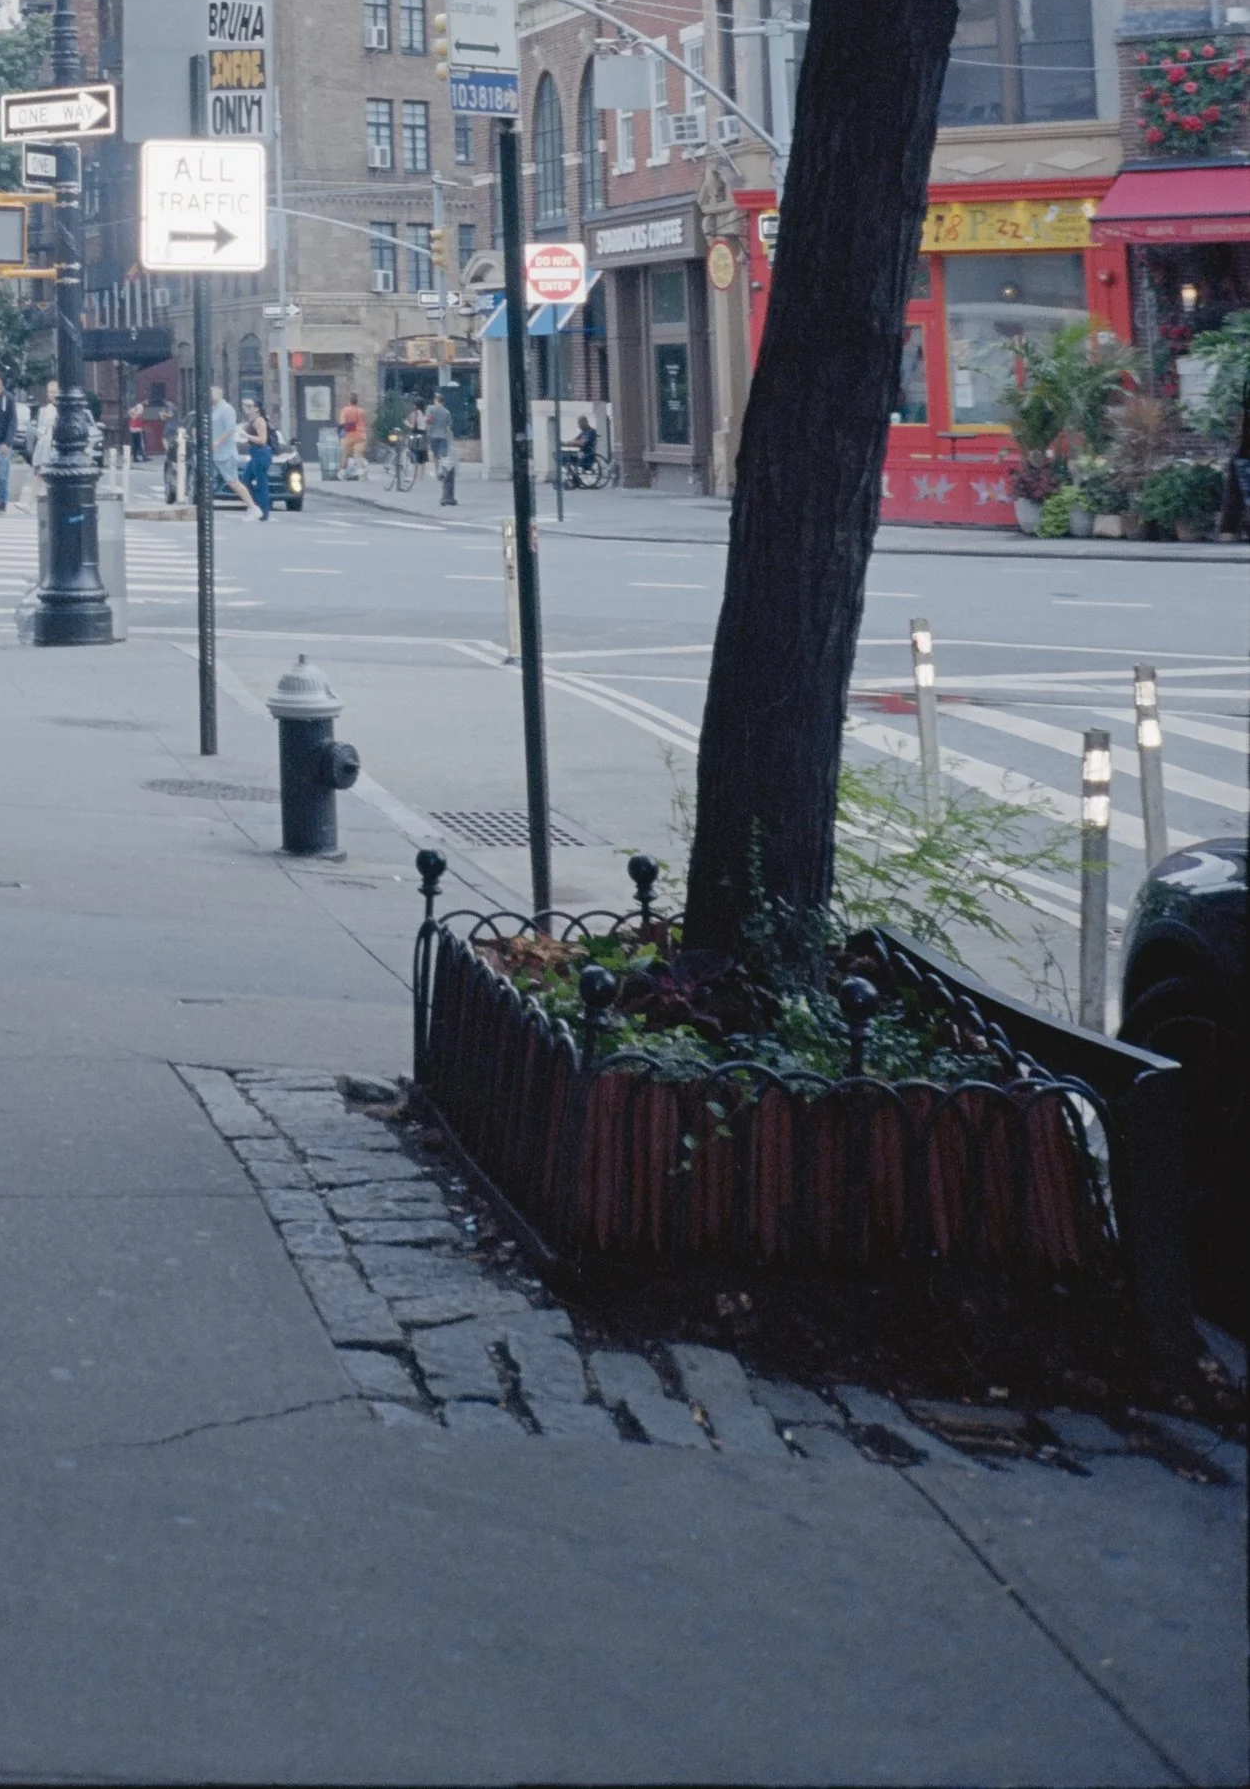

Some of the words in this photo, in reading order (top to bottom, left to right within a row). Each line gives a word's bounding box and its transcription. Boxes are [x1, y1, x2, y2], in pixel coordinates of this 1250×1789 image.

[209, 1, 264, 41] BRUHA
[451, 83, 504, 111] 103818
[18, 106, 48, 125] ONE
[62, 104, 95, 122] WAY
[32, 156, 50, 174] ONE
[174, 157, 234, 182] ALL
[158, 192, 251, 216] TRAFFIC
[596, 224, 648, 254] STARBUCKS
[648, 217, 683, 248] COFFEE
[535, 256, 551, 266] DO
[553, 256, 573, 266] NOT
[538, 280, 572, 291] ENTER
